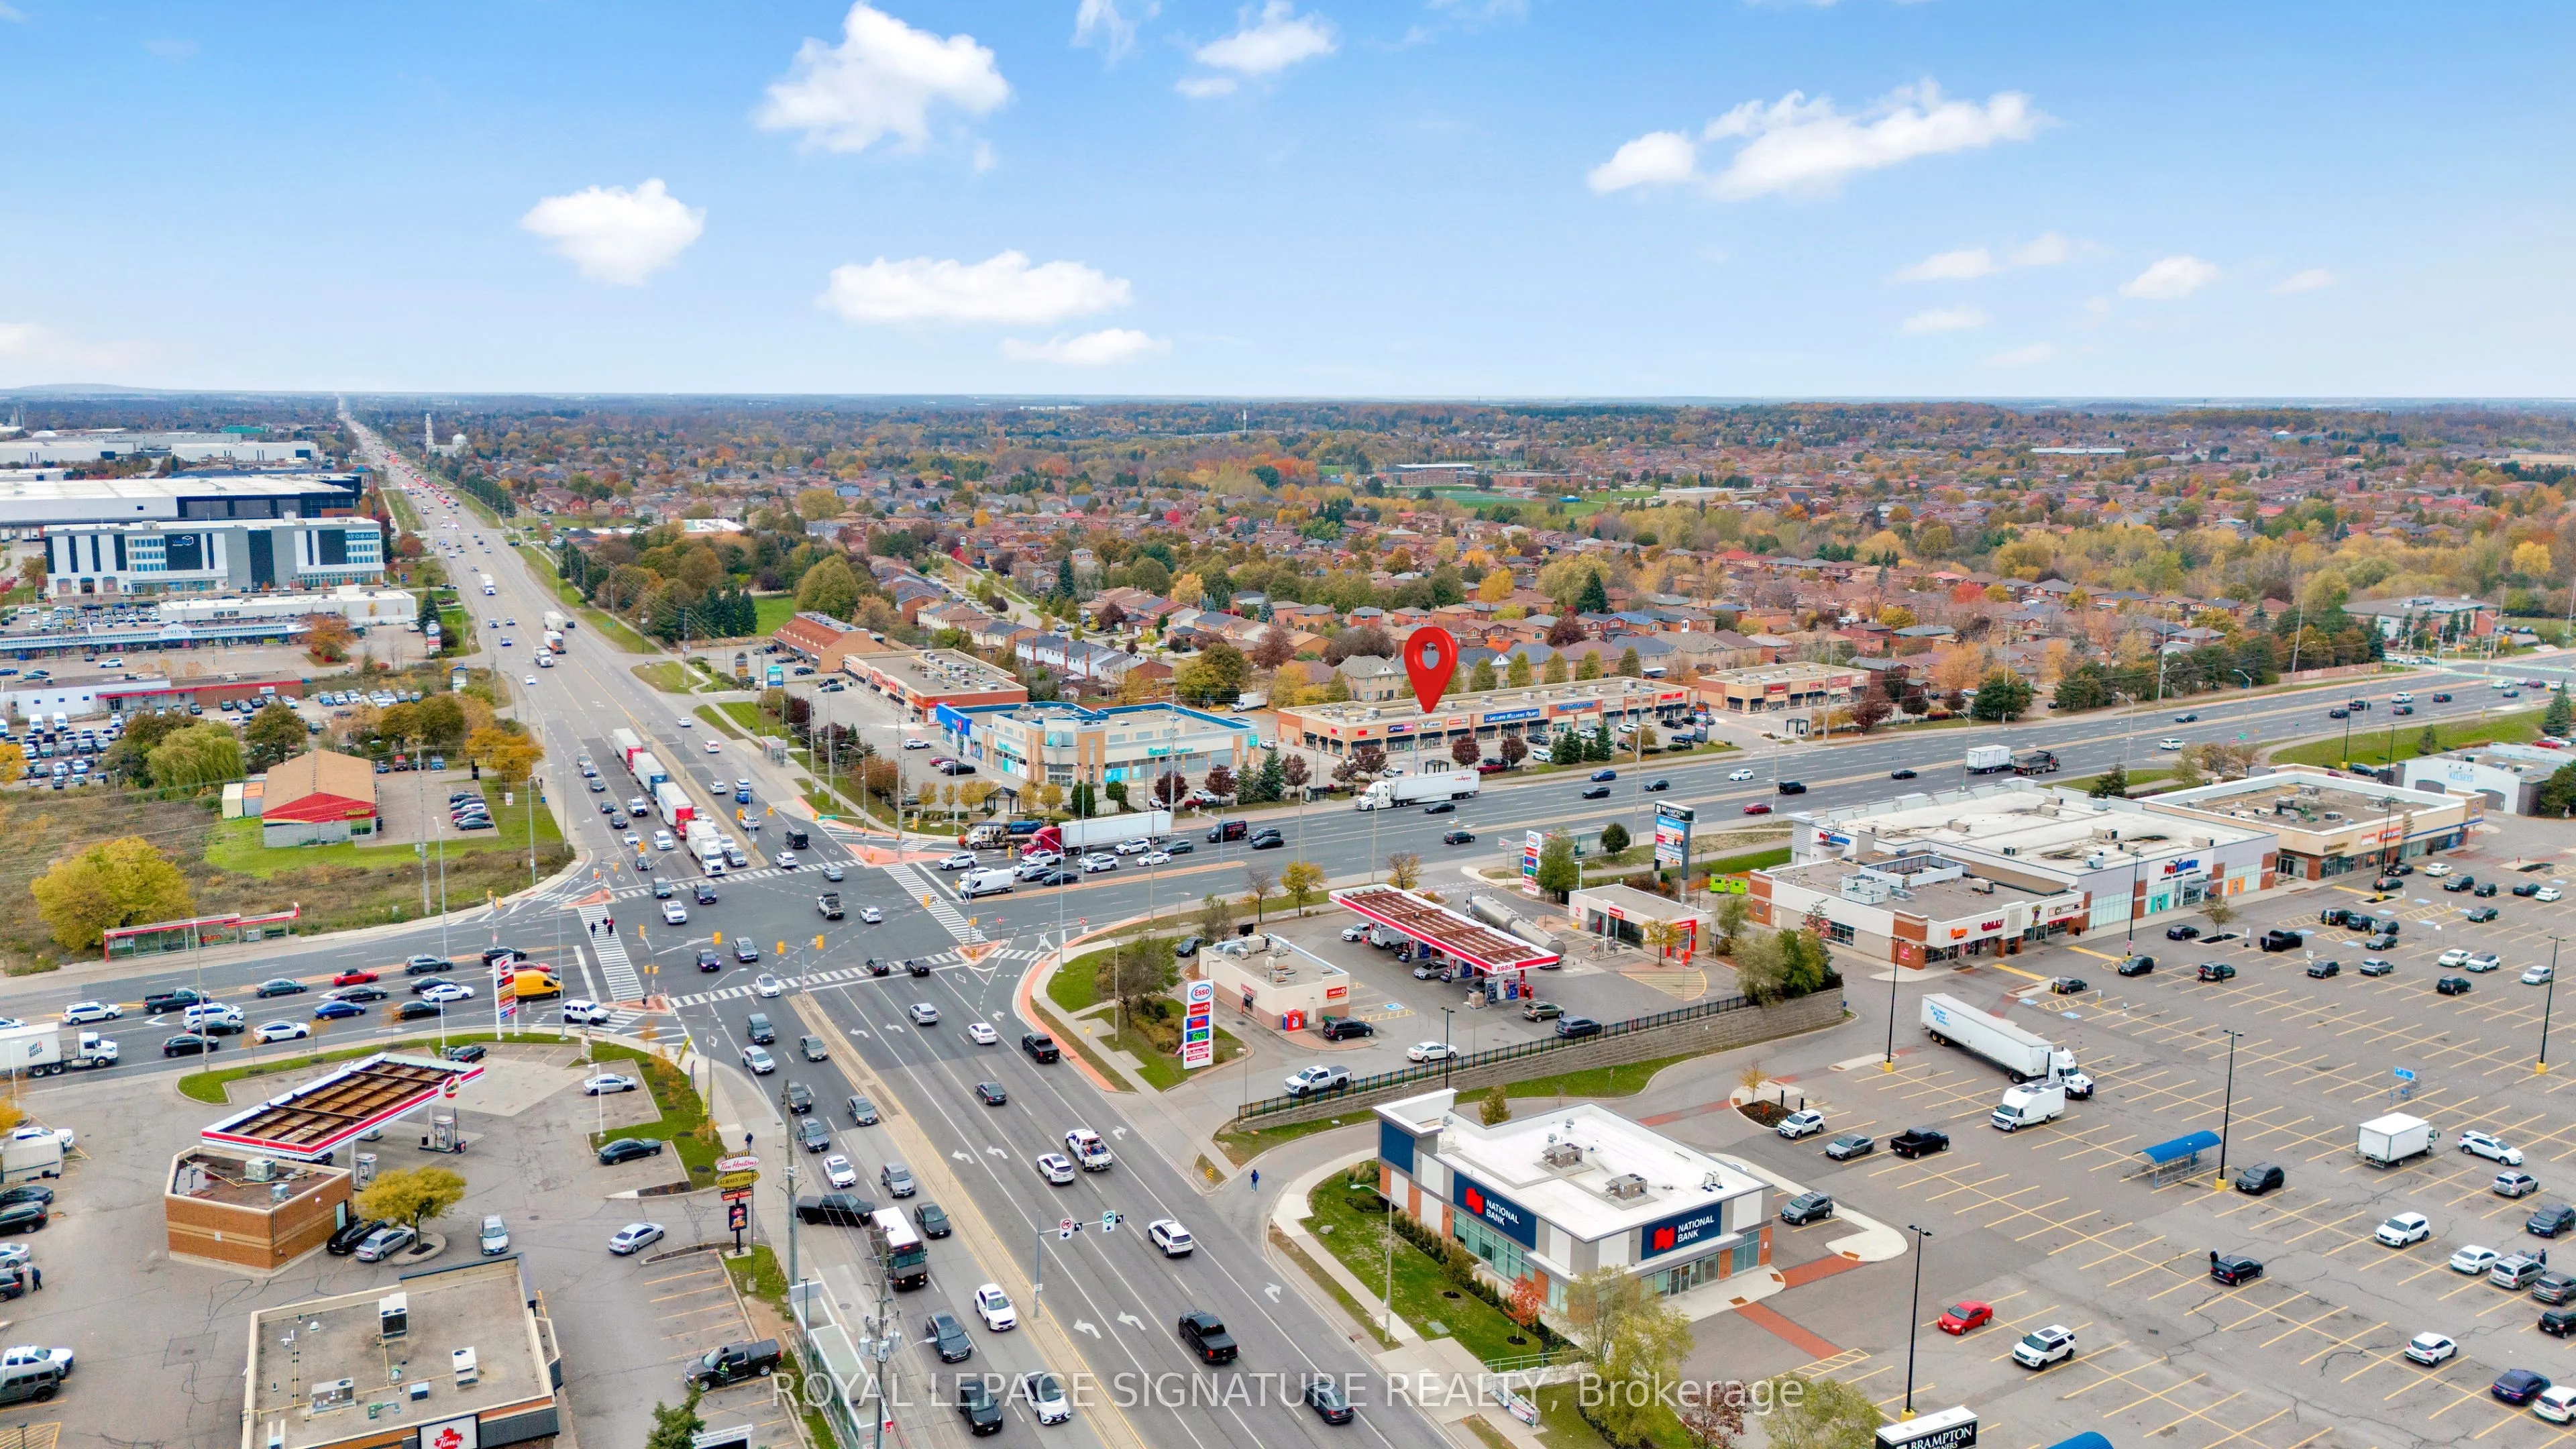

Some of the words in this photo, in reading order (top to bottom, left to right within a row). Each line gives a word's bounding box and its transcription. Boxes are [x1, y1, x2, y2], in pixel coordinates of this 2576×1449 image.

[2449, 772, 2474, 782] KELSEYS
[1661, 806, 1686, 817] BRAMPTON
[1980, 918, 2005, 932] SALLY
[1497, 964, 1513, 972] ESSO
[28, 1042, 38, 1053] DAY
[29, 1046, 43, 1058] ROSS
[720, 1163, 731, 1171] Tim
[732, 1160, 757, 1168] Hortons
[718, 1177, 739, 1185] ALWAYS
[739, 1174, 757, 1182] FRESH
[1486, 1199, 1519, 1224] NATIONAL
[1486, 1208, 1505, 1226] BANK
[1678, 1215, 1715, 1234] NATIONAL
[1677, 1228, 1699, 1243] BANK
[437, 1436, 460, 1448] Tims
[1911, 1425, 1973, 1449] BRAMPTON
